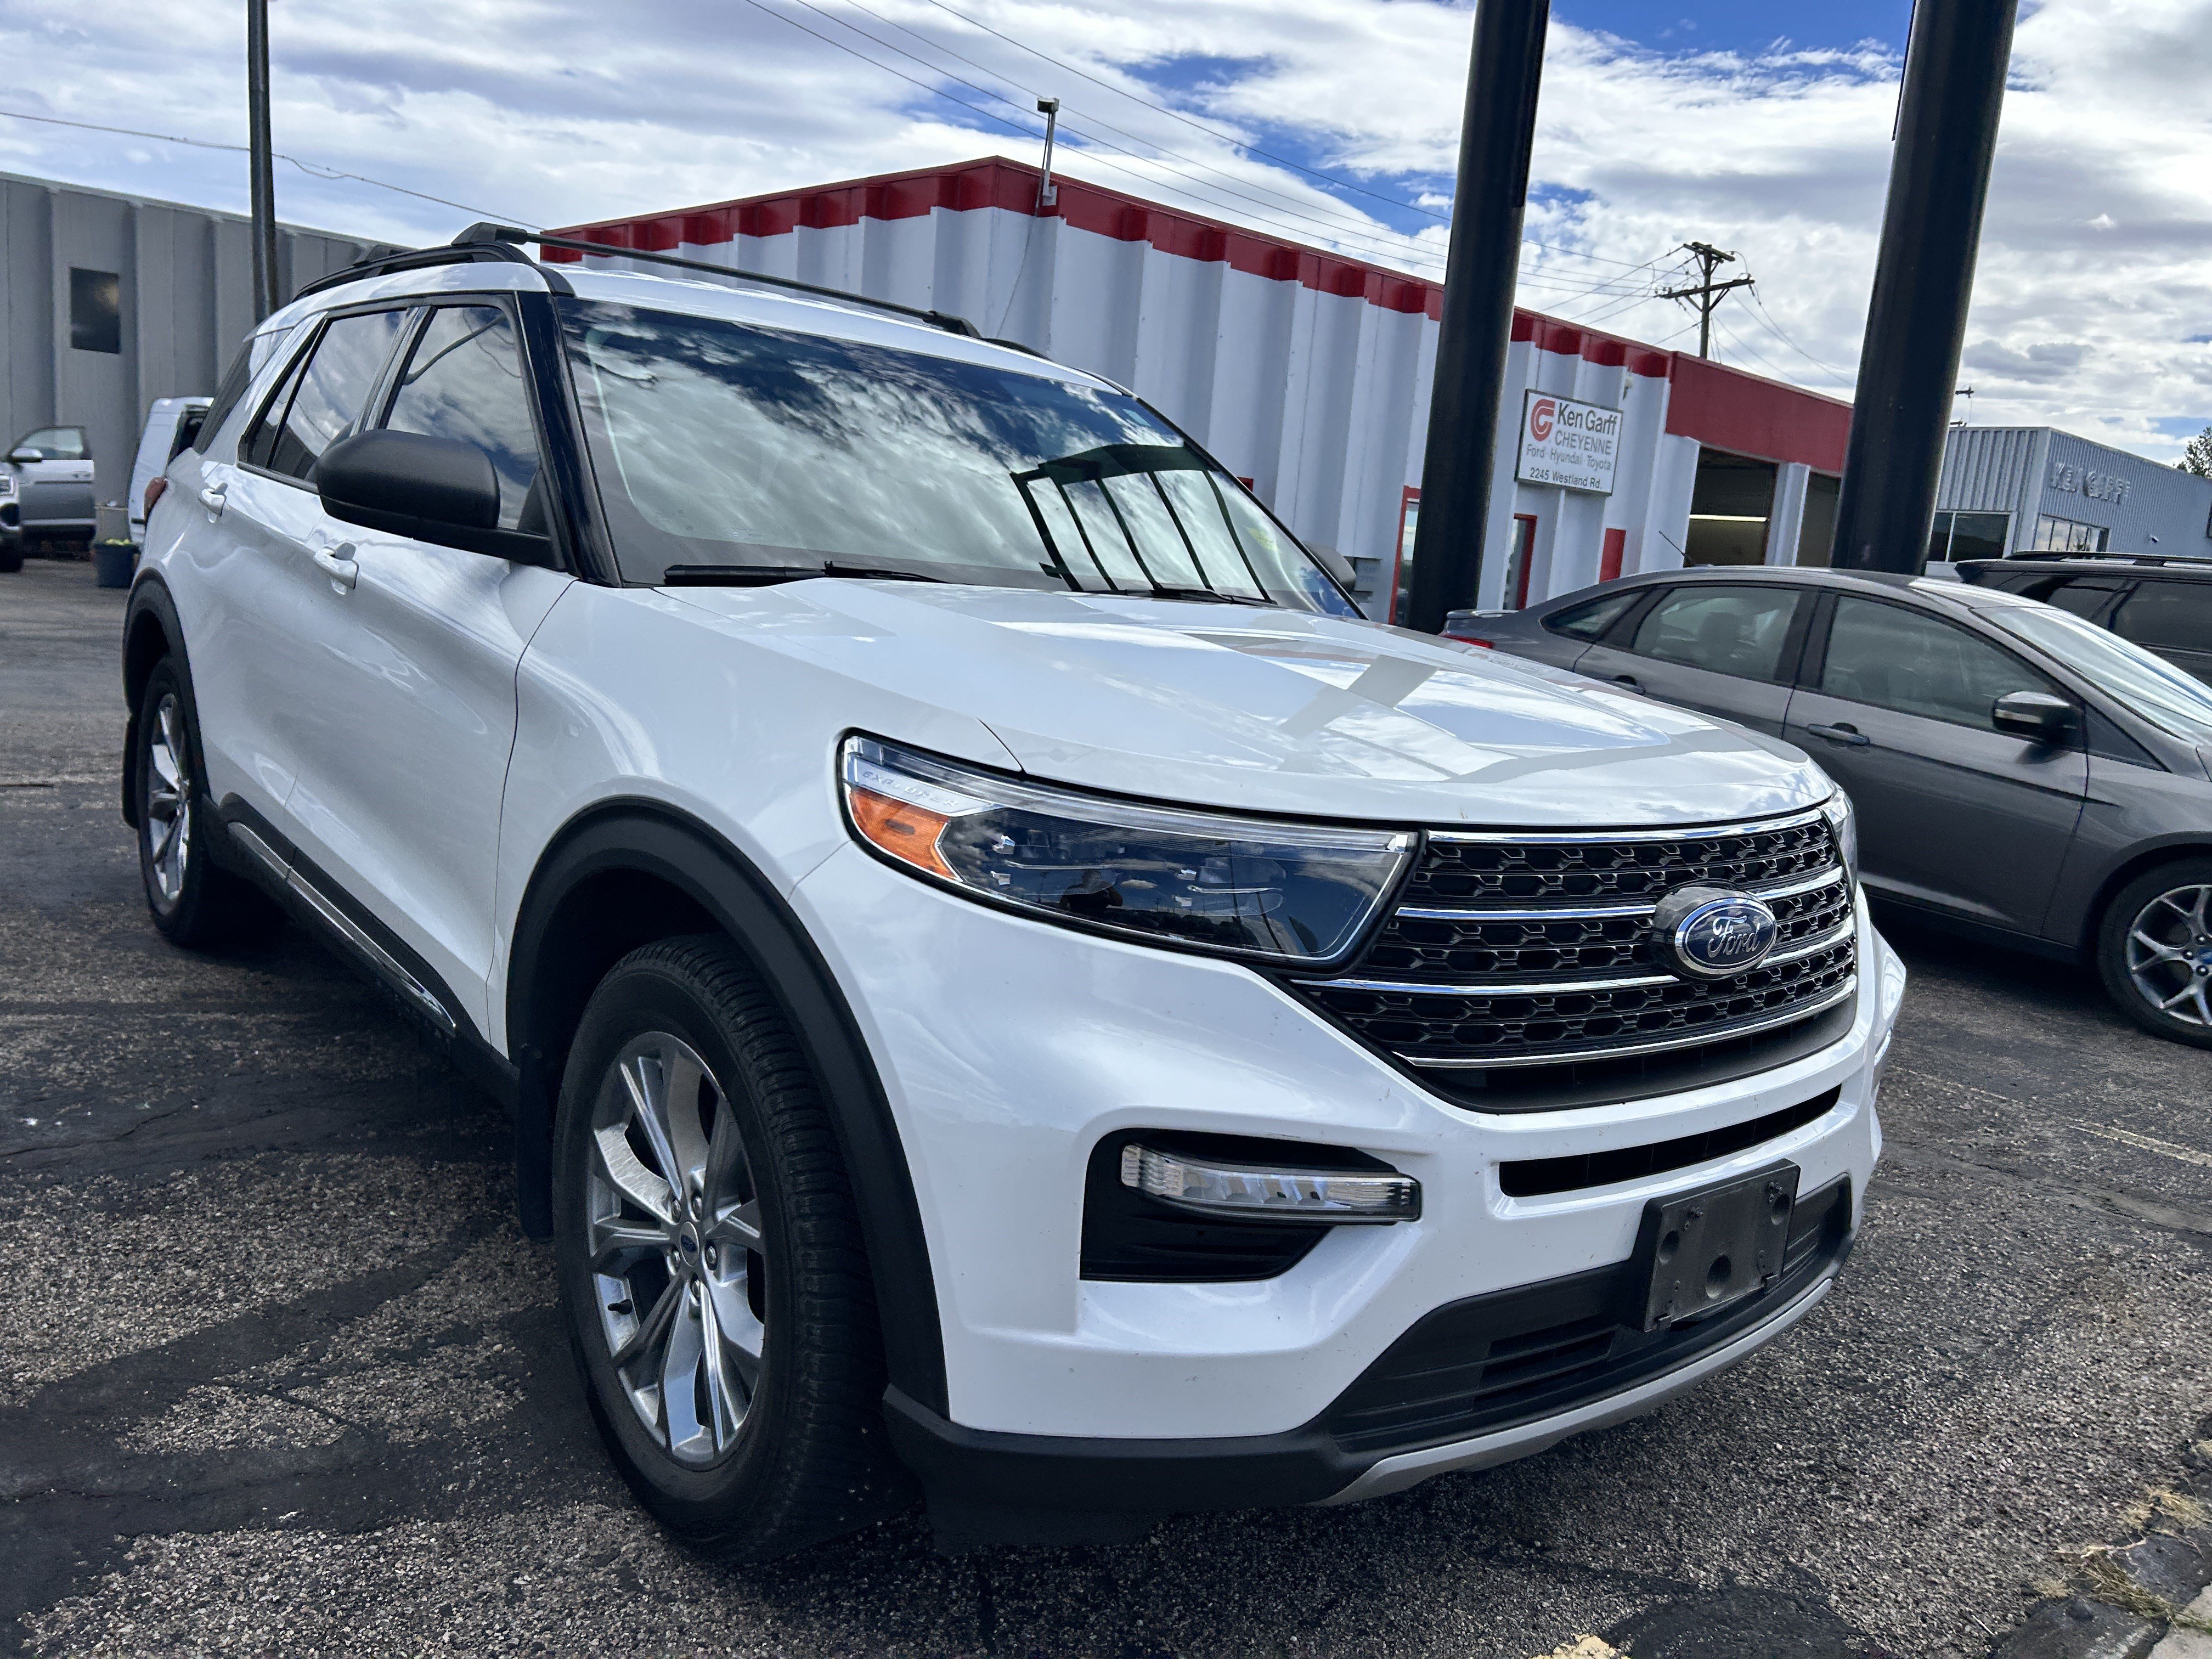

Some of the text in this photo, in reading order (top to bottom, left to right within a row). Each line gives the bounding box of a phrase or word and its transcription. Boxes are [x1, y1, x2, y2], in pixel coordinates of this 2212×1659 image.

[1557, 403, 1618, 436] Ken Garff
[1526, 444, 1611, 471] Ford Hyundai Toyota
[1555, 430, 1612, 455] CHEYENNE
[1530, 467, 1602, 489] 2245 Westland Rd.
[861, 771, 960, 808] EXPLORER
[1707, 915, 1761, 958] Ford
